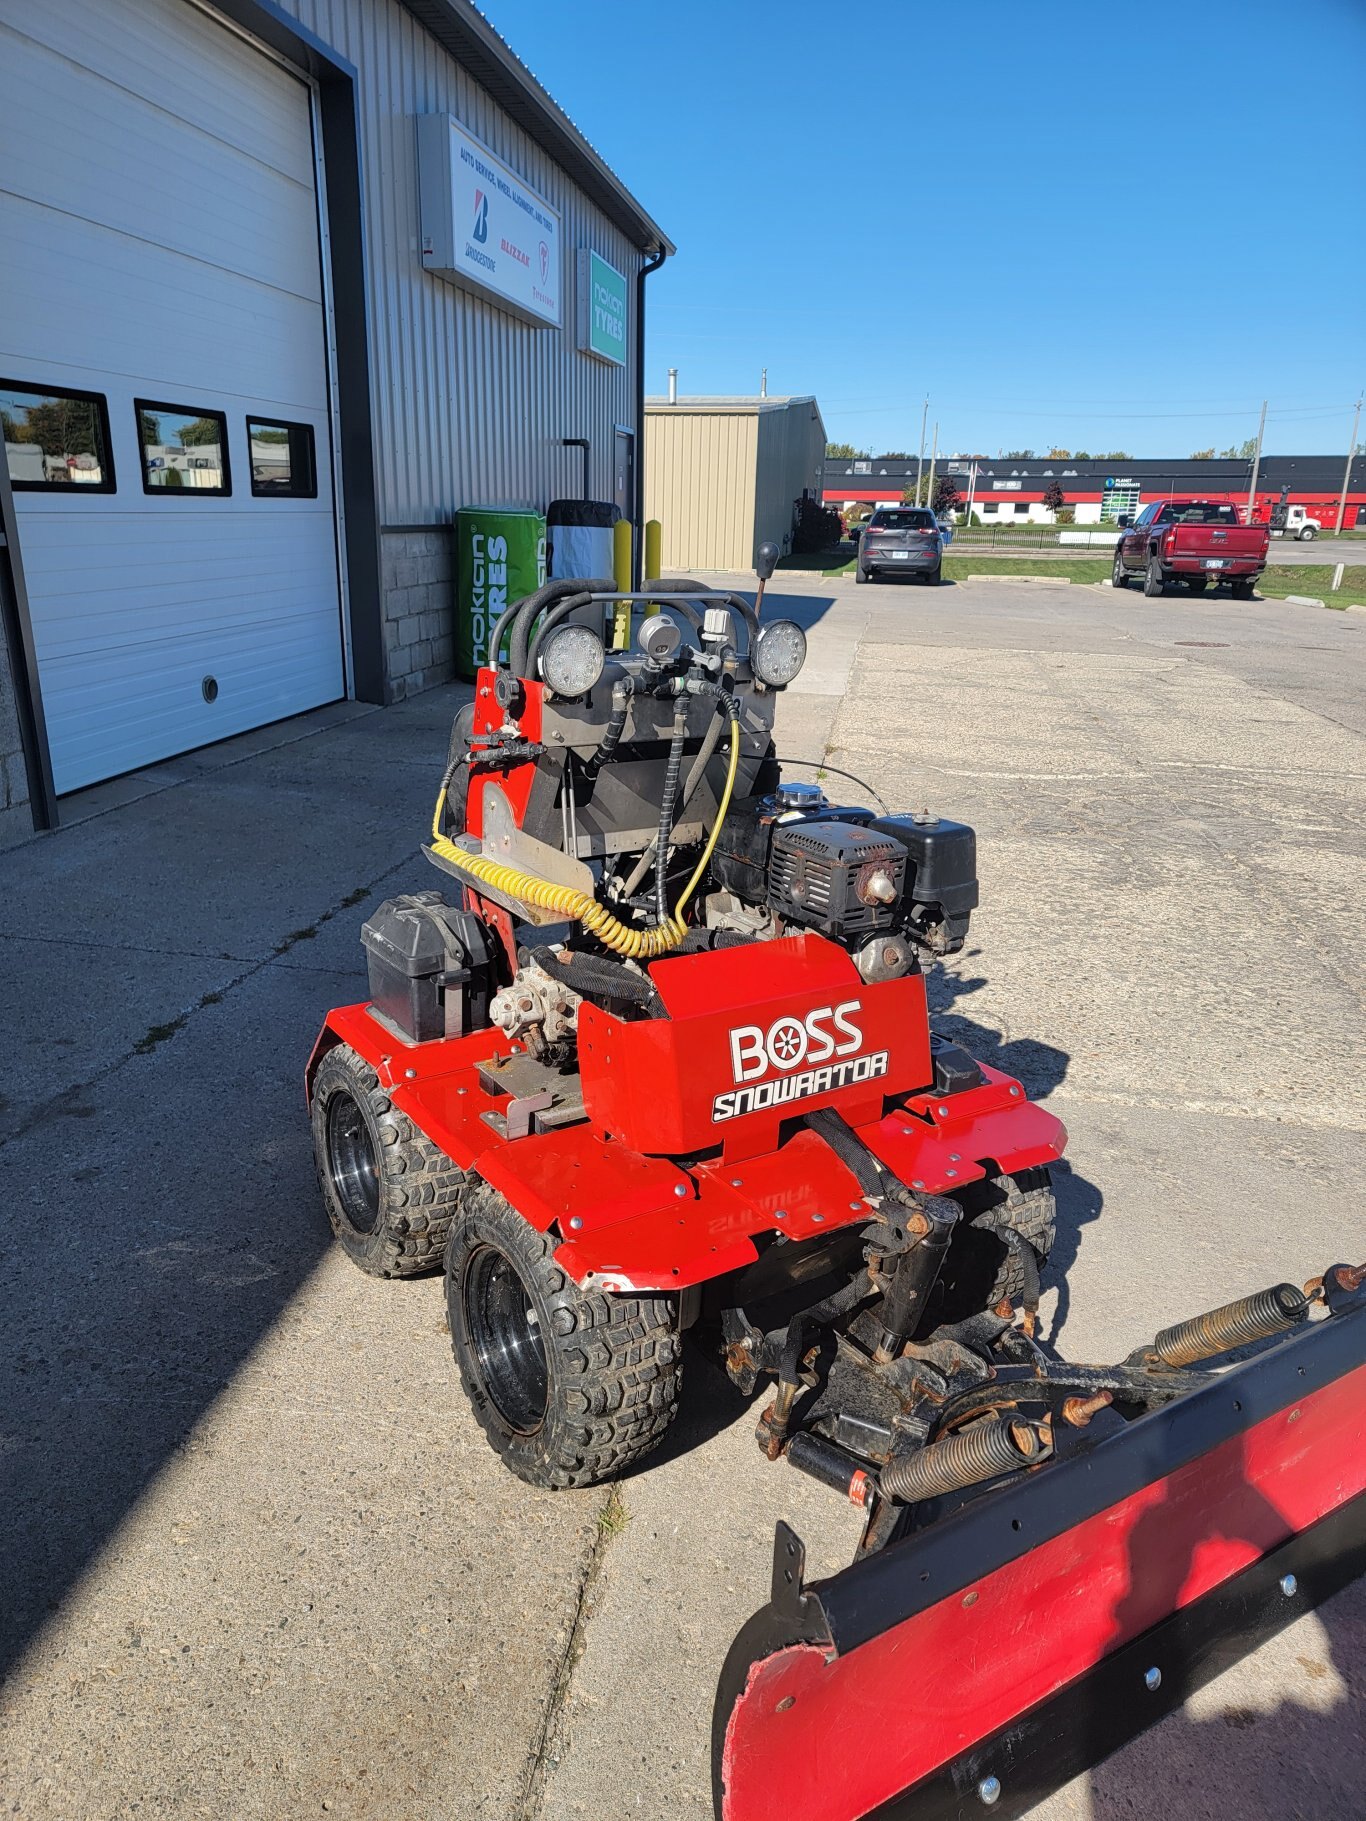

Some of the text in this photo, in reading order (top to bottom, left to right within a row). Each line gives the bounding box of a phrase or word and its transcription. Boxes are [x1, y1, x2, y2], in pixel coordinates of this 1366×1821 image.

[460, 147, 475, 169] AUTO
[496, 177, 511, 199] WHEEL
[535, 210, 543, 225] AND
[543, 217, 553, 234] TIRES
[465, 242, 496, 273] BRIDGESTONE
[501, 238, 530, 268] BLIZZAK
[594, 305, 623, 341] TYRES
[729, 999, 863, 1085] BOSS
[713, 1051, 888, 1122] SNOWRATOR
